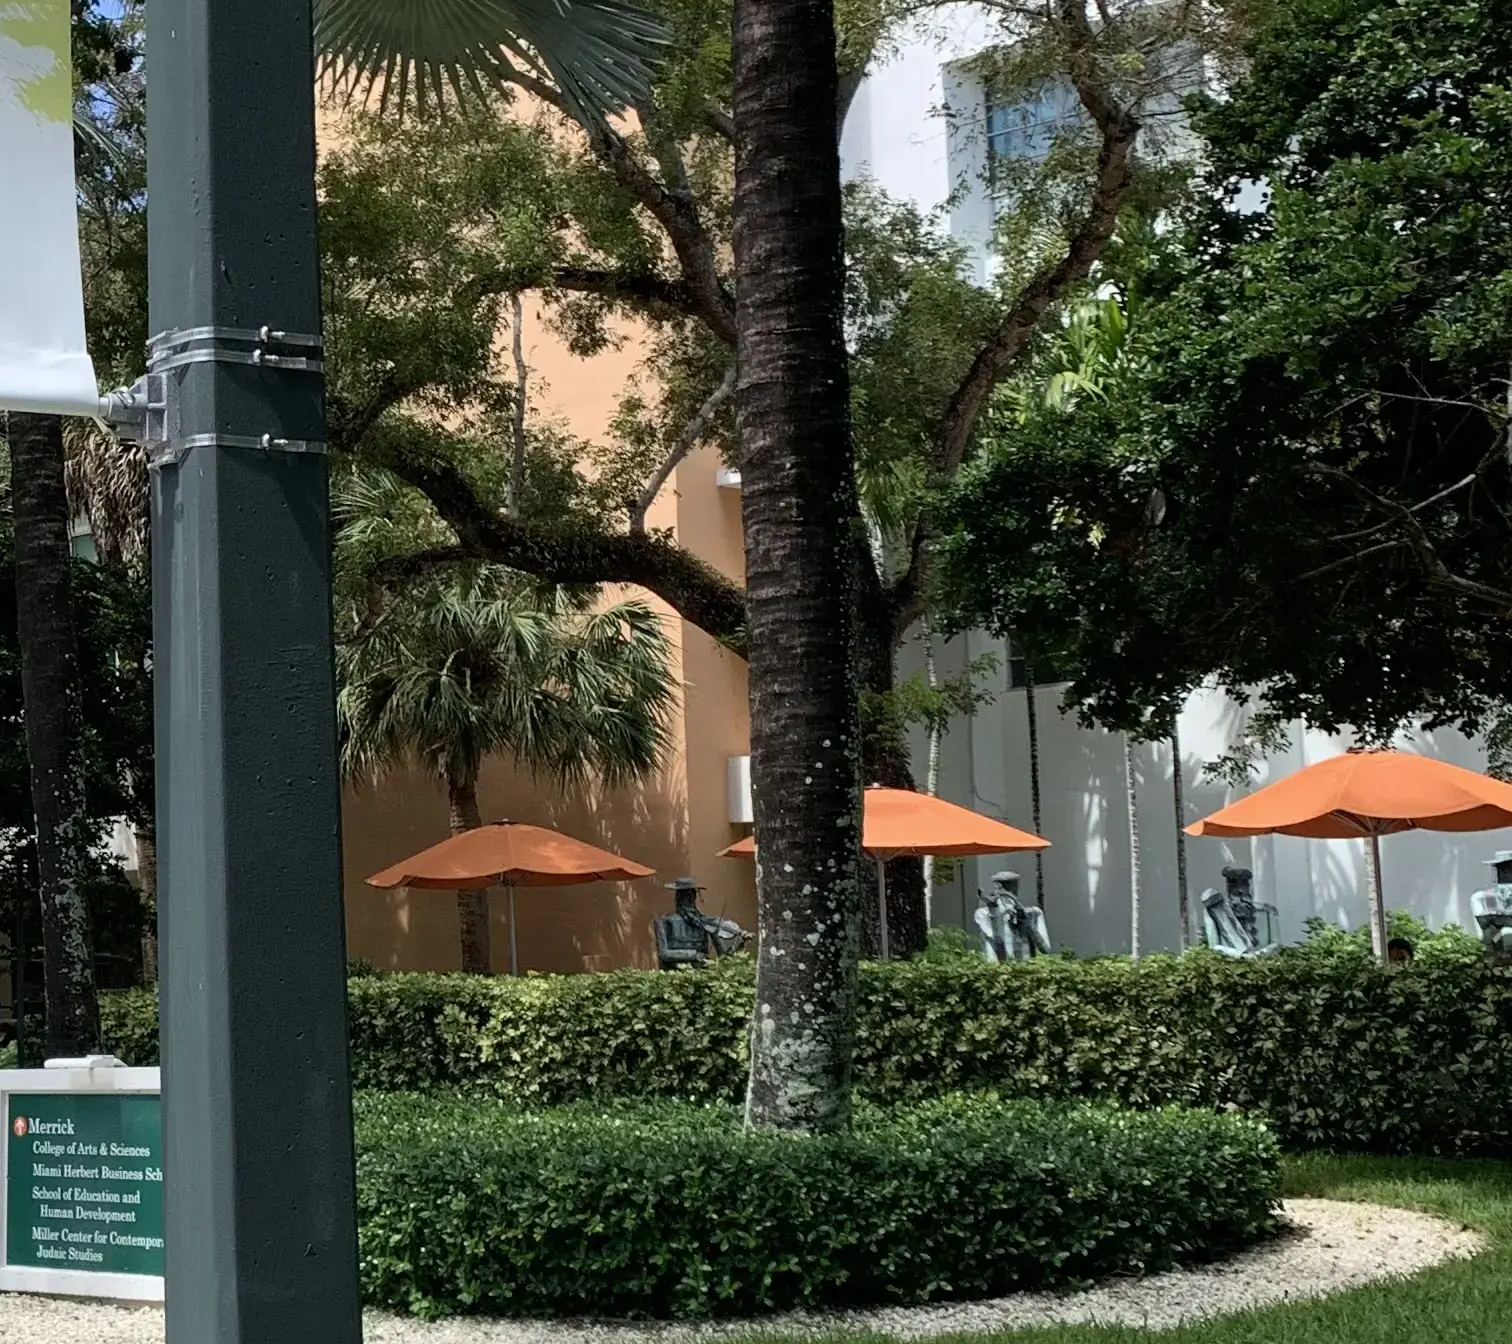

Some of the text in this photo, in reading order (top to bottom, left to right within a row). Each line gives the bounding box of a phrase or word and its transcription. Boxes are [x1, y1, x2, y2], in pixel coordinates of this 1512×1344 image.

[28, 1117, 75, 1135] Merrick
[33, 1141, 151, 1157] College of Arts & Sciences
[32, 1163, 163, 1181] Miami Herbert Business Sch
[32, 1186, 141, 1204] School of Education and
[40, 1204, 136, 1224] Human Development
[32, 1226, 60, 1241] Miller
[61, 1228, 93, 1243] Center
[94, 1230, 107, 1245] for
[36, 1245, 104, 1263] Judaic Studies
